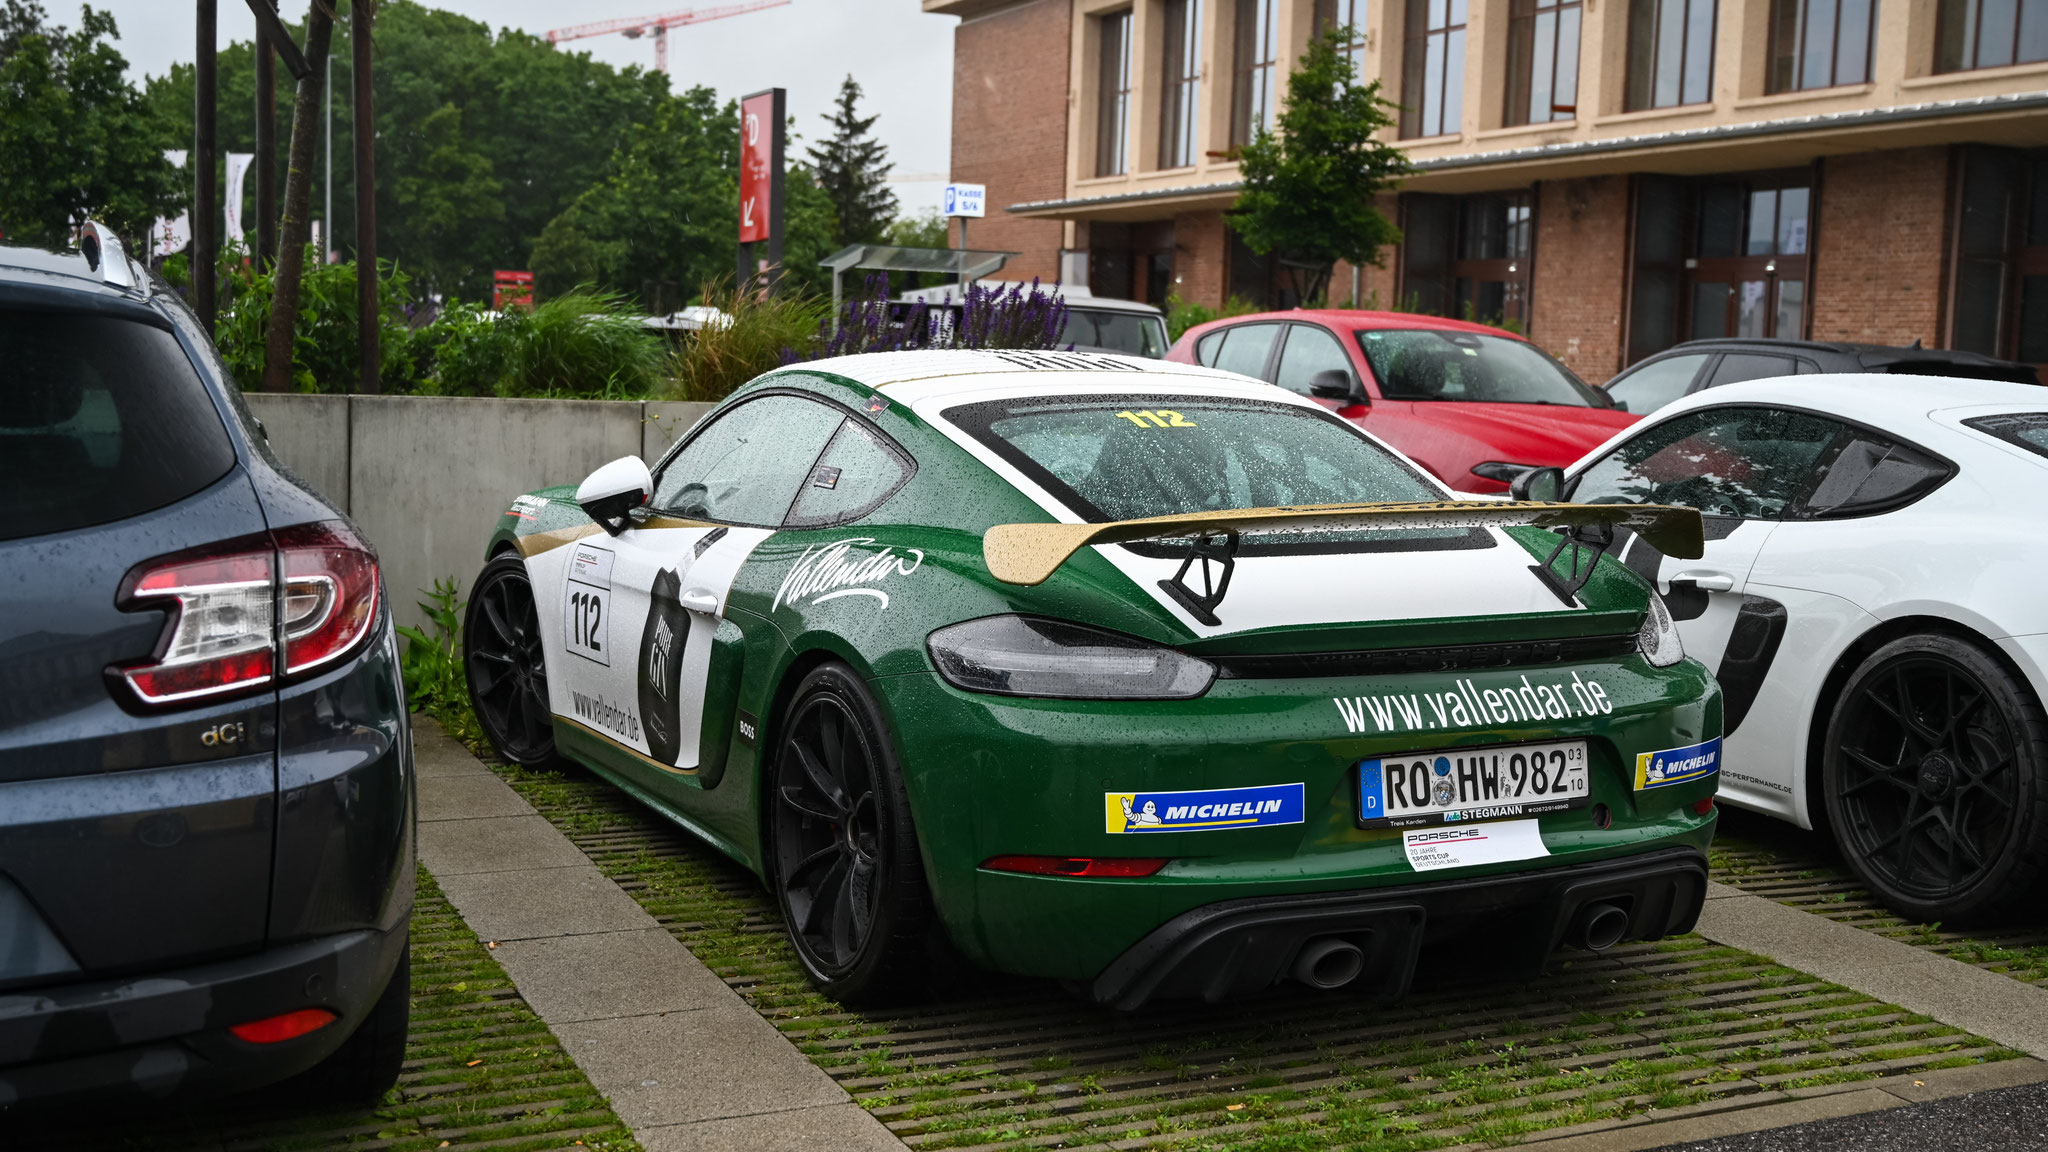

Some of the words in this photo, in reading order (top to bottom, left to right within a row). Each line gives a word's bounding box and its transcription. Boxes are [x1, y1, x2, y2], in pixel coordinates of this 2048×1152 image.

[1115, 410, 1197, 428] 112
[771, 538, 924, 613] Vallendar
[571, 591, 602, 652] 112
[1333, 671, 1613, 733] www.vallendar.de
[573, 690, 639, 742] www.vallendar.de
[739, 720, 755, 740] BOSS
[1568, 748, 1582, 760] 03
[1665, 751, 1715, 774] MICHELIN
[1385, 761, 1431, 810] RO
[1457, 755, 1499, 802] HW
[1510, 750, 1567, 797] 982
[1571, 778, 1583, 791] 10
[1719, 770, 1792, 794] BC-PERFORMANCE.DE
[1165, 799, 1282, 820] MICHELIN
[1367, 796, 1376, 809] D
[1462, 805, 1523, 820] STEGMANN
[1408, 829, 1479, 843] PORSCHE
[1412, 854, 1436, 862] SPORTS
[1437, 852, 1450, 860] CUP
[1420, 847, 1437, 855] JAHRE
[1415, 858, 1460, 868] DEUTSCHLAND
